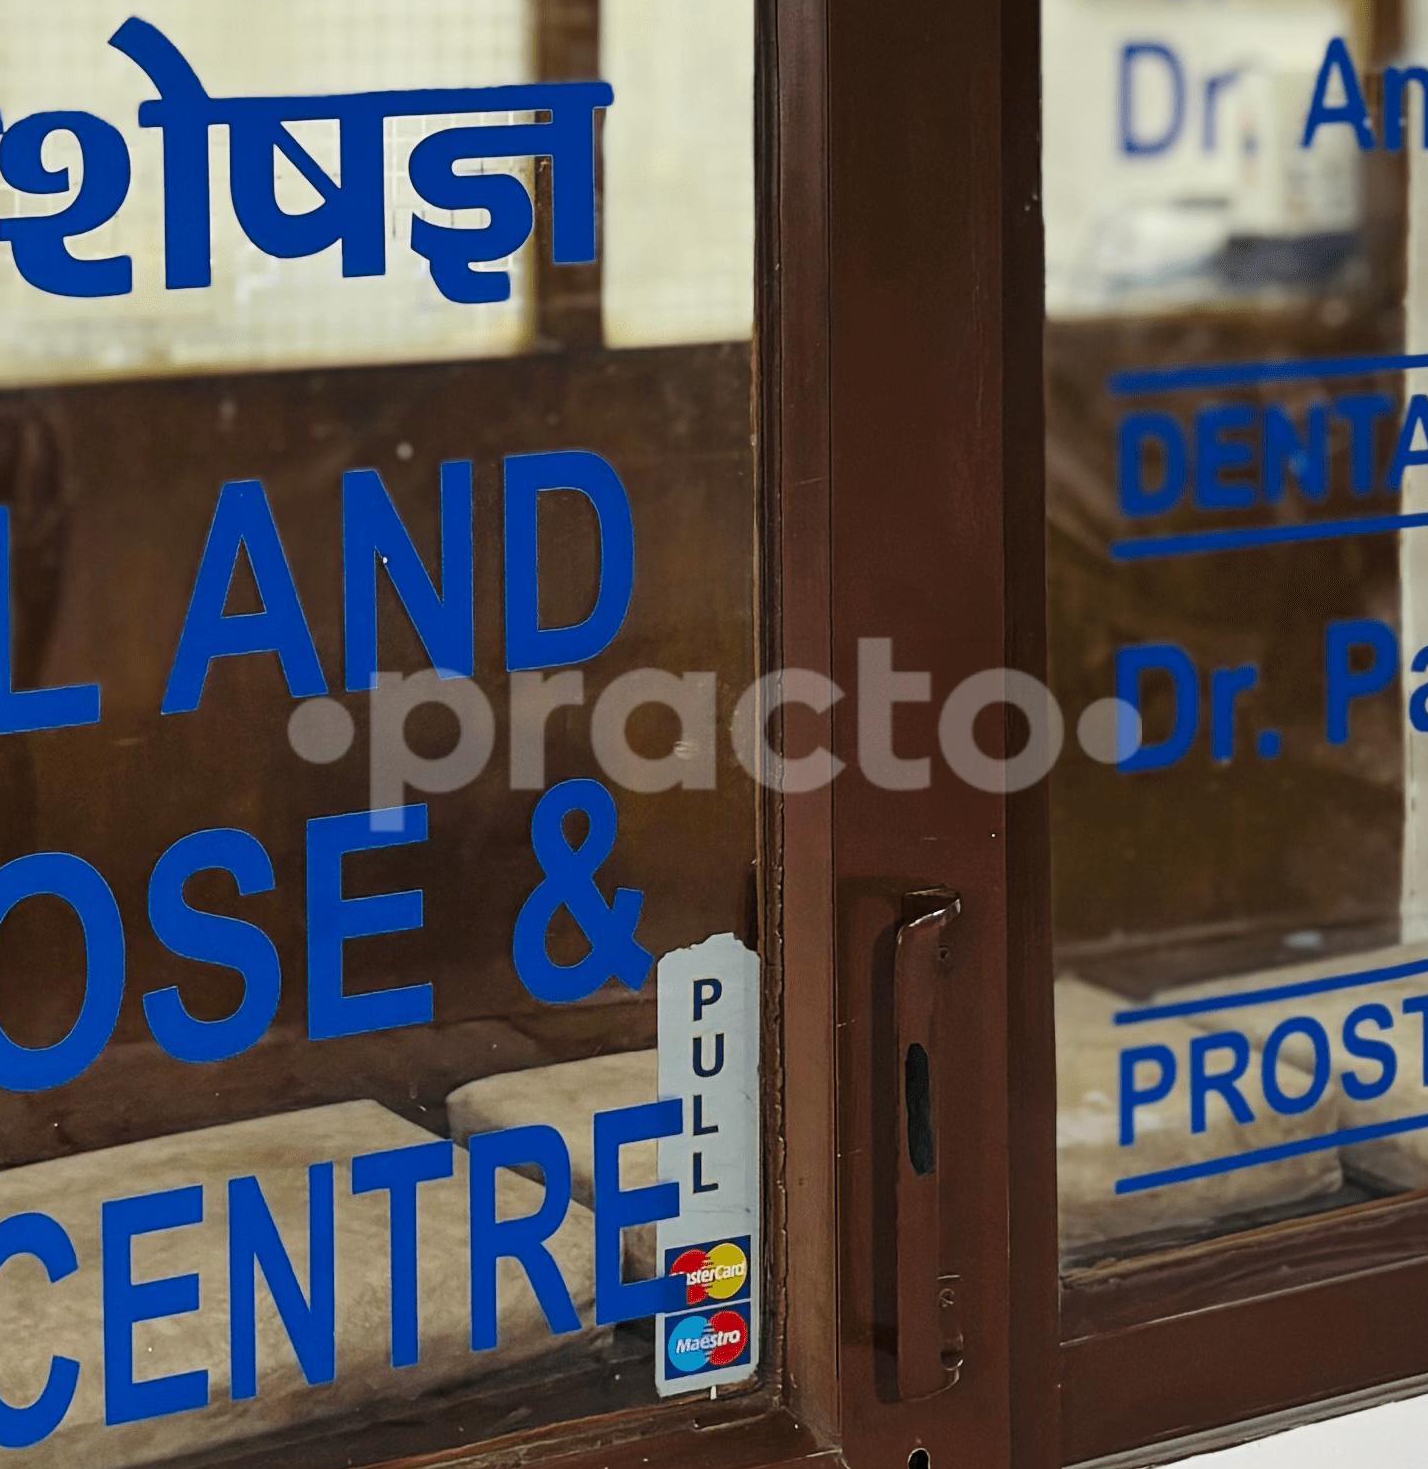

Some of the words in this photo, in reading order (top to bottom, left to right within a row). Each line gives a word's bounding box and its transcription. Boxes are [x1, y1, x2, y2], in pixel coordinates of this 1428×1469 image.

[1119, 41, 1261, 160] Dr.
[160, 449, 636, 716] AND
[1115, 642, 1282, 774] Dr.
[512, 778, 655, 1005] &
[691, 977, 726, 1195] PULL
[675, 1329, 741, 1355] Maestro
